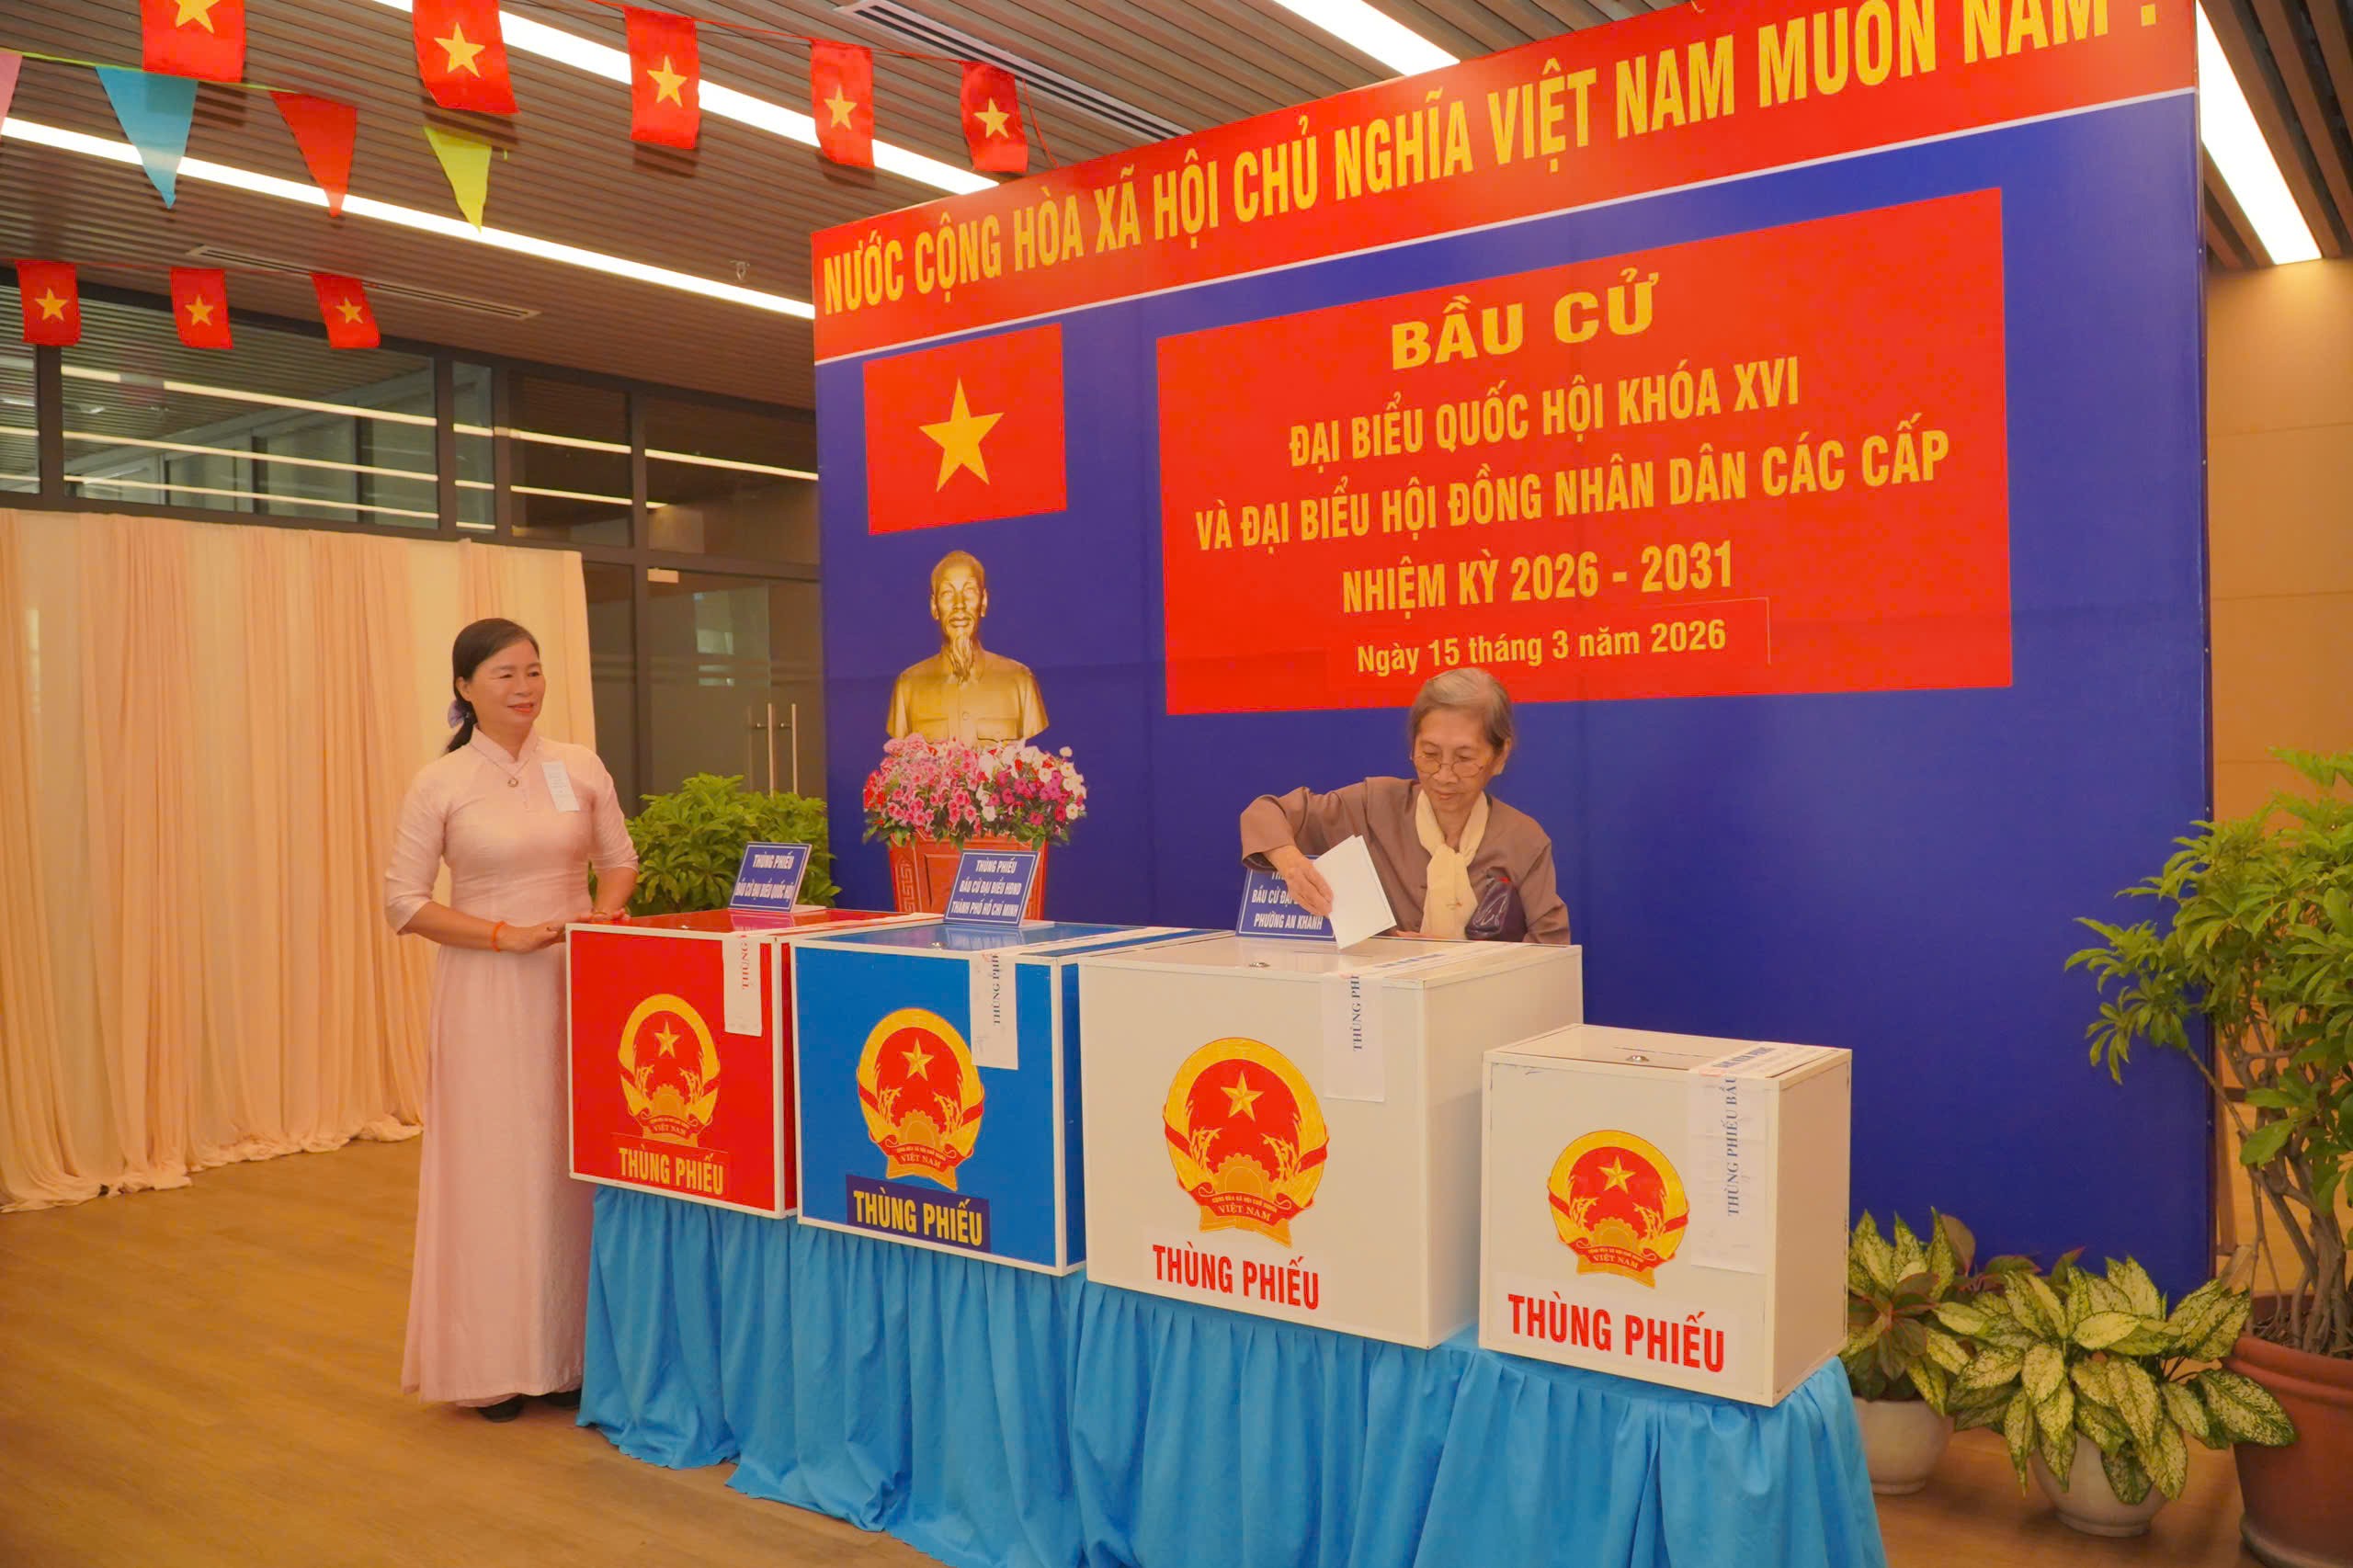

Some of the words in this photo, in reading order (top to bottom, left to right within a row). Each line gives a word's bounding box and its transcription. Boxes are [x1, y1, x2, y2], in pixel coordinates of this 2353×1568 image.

[824, 230, 904, 315] NƯỚC
[915, 211, 1002, 303] CỘNG
[1013, 186, 1085, 272] HÒA
[1094, 164, 1142, 254] XÃ
[1153, 148, 1219, 249] HỘI
[1233, 114, 1318, 223] CHỦ
[1334, 87, 1474, 201] NGHĨA
[1487, 57, 1597, 173] VIỆT
[1615, 34, 1735, 140] NAM
[1391, 294, 1524, 370] BẦU
[1553, 267, 1660, 344] CỬ
[1289, 419, 1340, 474] ĐẠI
[1351, 391, 1424, 460] BIỂU
[1436, 379, 1529, 453] QUỐC
[1542, 374, 1604, 443] HỘI
[1618, 359, 1722, 426] KHÓA
[1733, 356, 1799, 412] XVI
[1196, 498, 1233, 551] VÀ
[1240, 501, 1290, 555] ĐẠI
[1300, 474, 1370, 542] BIỂU
[1381, 476, 1437, 541] HỘI
[1447, 462, 1542, 528] ĐỒNG
[1555, 452, 1654, 517] NHÂN
[1669, 442, 1746, 506] DÂN
[1761, 430, 1845, 497] CÁC
[1861, 412, 1949, 487] CẤP
[1342, 555, 1447, 620] NHIỆM
[1458, 548, 1500, 607] KỲ
[1510, 551, 1599, 602] 2026
[1611, 568, 1628, 584] -
[1641, 539, 1733, 593] 2031
[1357, 642, 1420, 678] Ngày
[1427, 636, 1460, 667] 15
[1468, 629, 1543, 669] tháng
[1552, 629, 1570, 660] 3
[1578, 625, 1640, 659] năm
[1650, 619, 1726, 653] 2026
[975, 857, 997, 872] THÙNG
[1284, 915, 1297, 929] AN
[1349, 1003, 1362, 1051] THÙNG
[1720, 1108, 1738, 1156] PHIẾU
[618, 1143, 671, 1185] THÙNG
[676, 1153, 724, 1195] PHIẾU
[1723, 1162, 1739, 1217] THÙNG
[853, 1187, 917, 1233] THÙNG
[923, 1199, 983, 1246] PHIẾU
[1152, 1241, 1233, 1294] THÙNG
[1243, 1256, 1319, 1311] PHIẾU
[1507, 1290, 1612, 1353] THÙNG
[1624, 1311, 1725, 1373] PHIẾU
